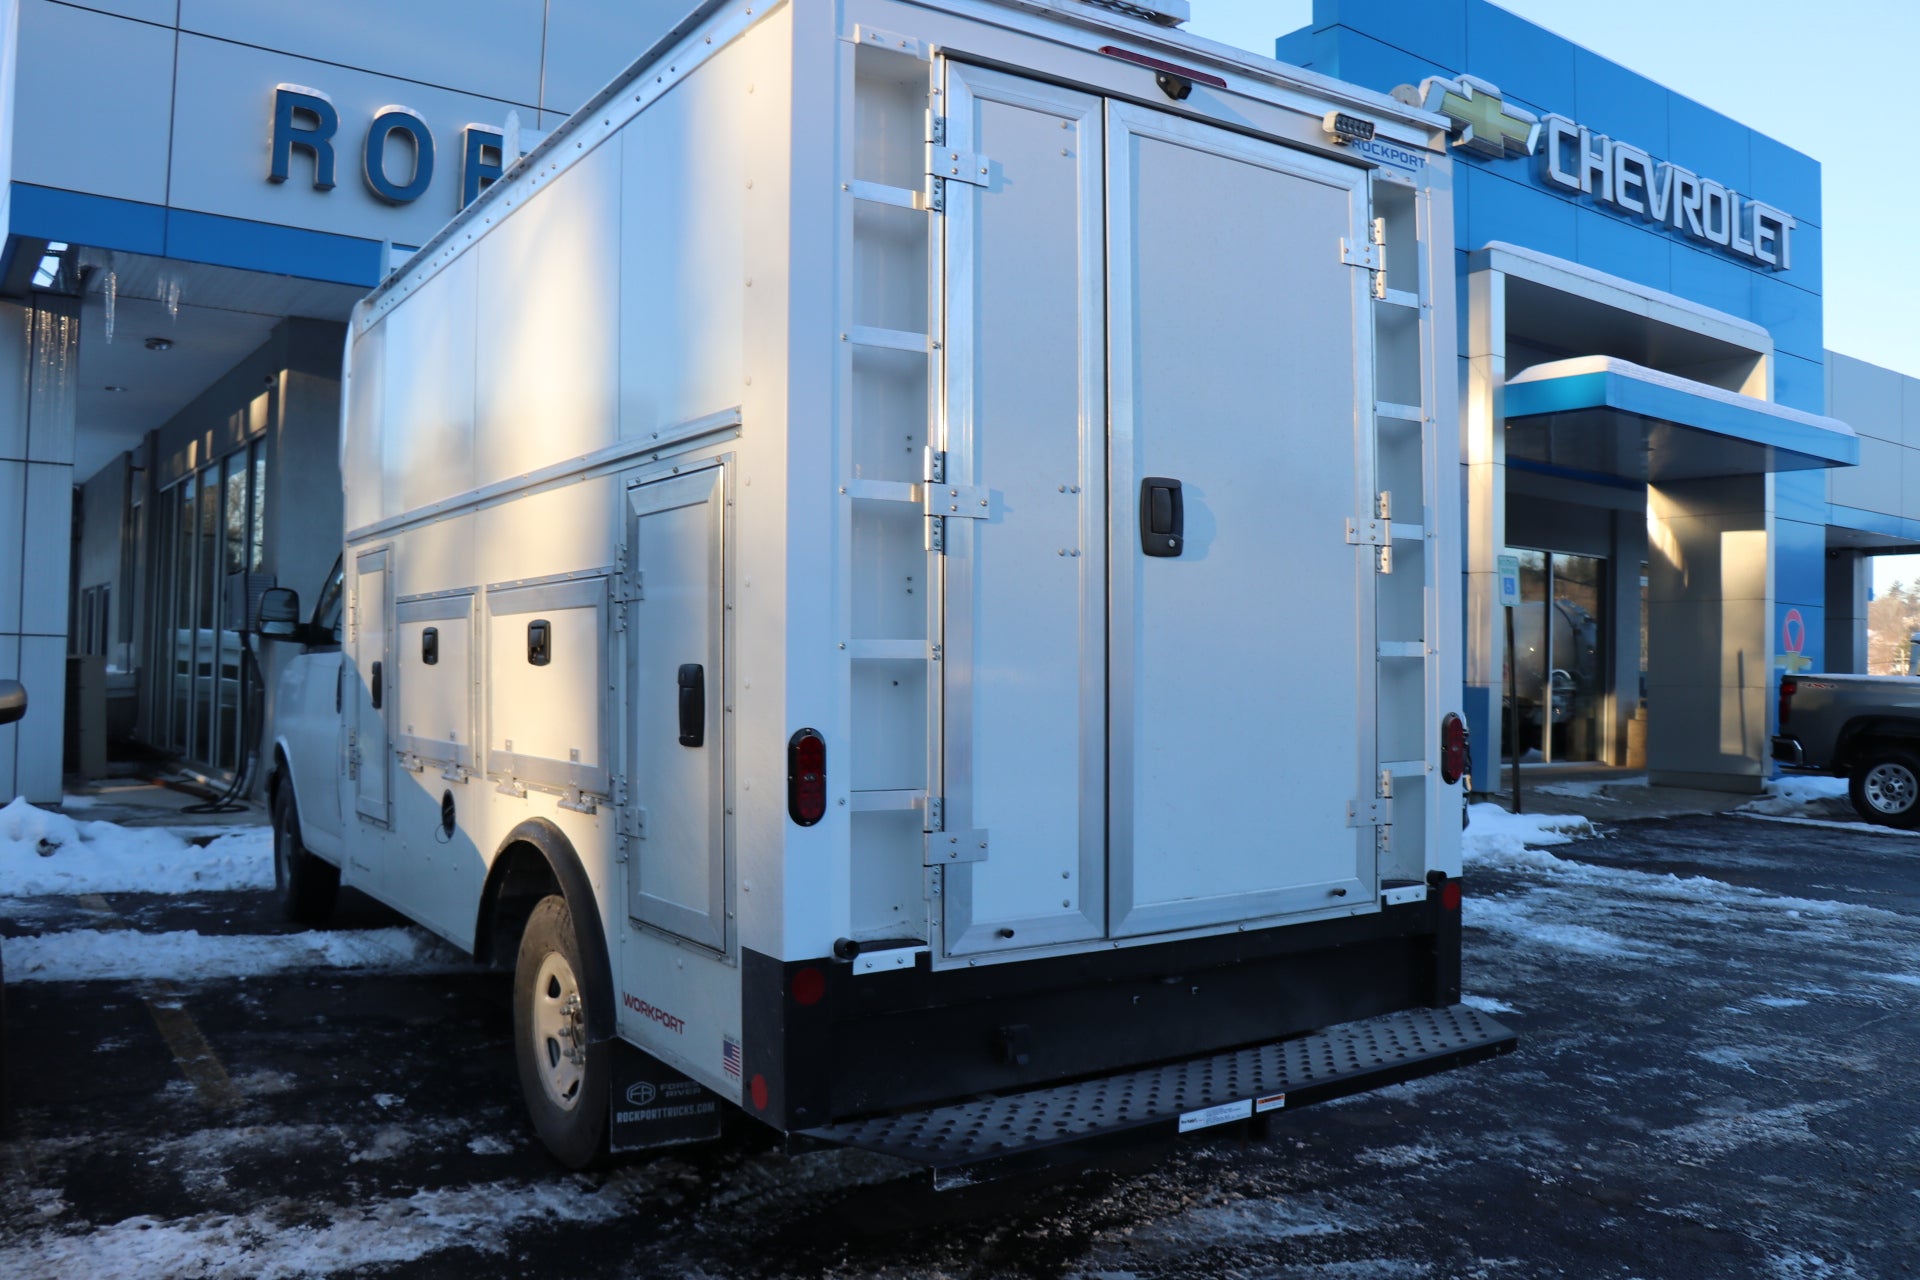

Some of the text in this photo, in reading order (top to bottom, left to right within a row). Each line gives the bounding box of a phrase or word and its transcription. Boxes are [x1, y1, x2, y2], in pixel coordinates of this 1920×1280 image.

[1352, 138, 1426, 168] ROCKPORT
[1542, 114, 1796, 271] CHEVROLET
[623, 992, 685, 1034] WORKPORT
[660, 1080, 700, 1091] FORES
[665, 1087, 701, 1098] RIVER
[616, 1101, 715, 1124] ROCKPORTTRUCKS.COM
